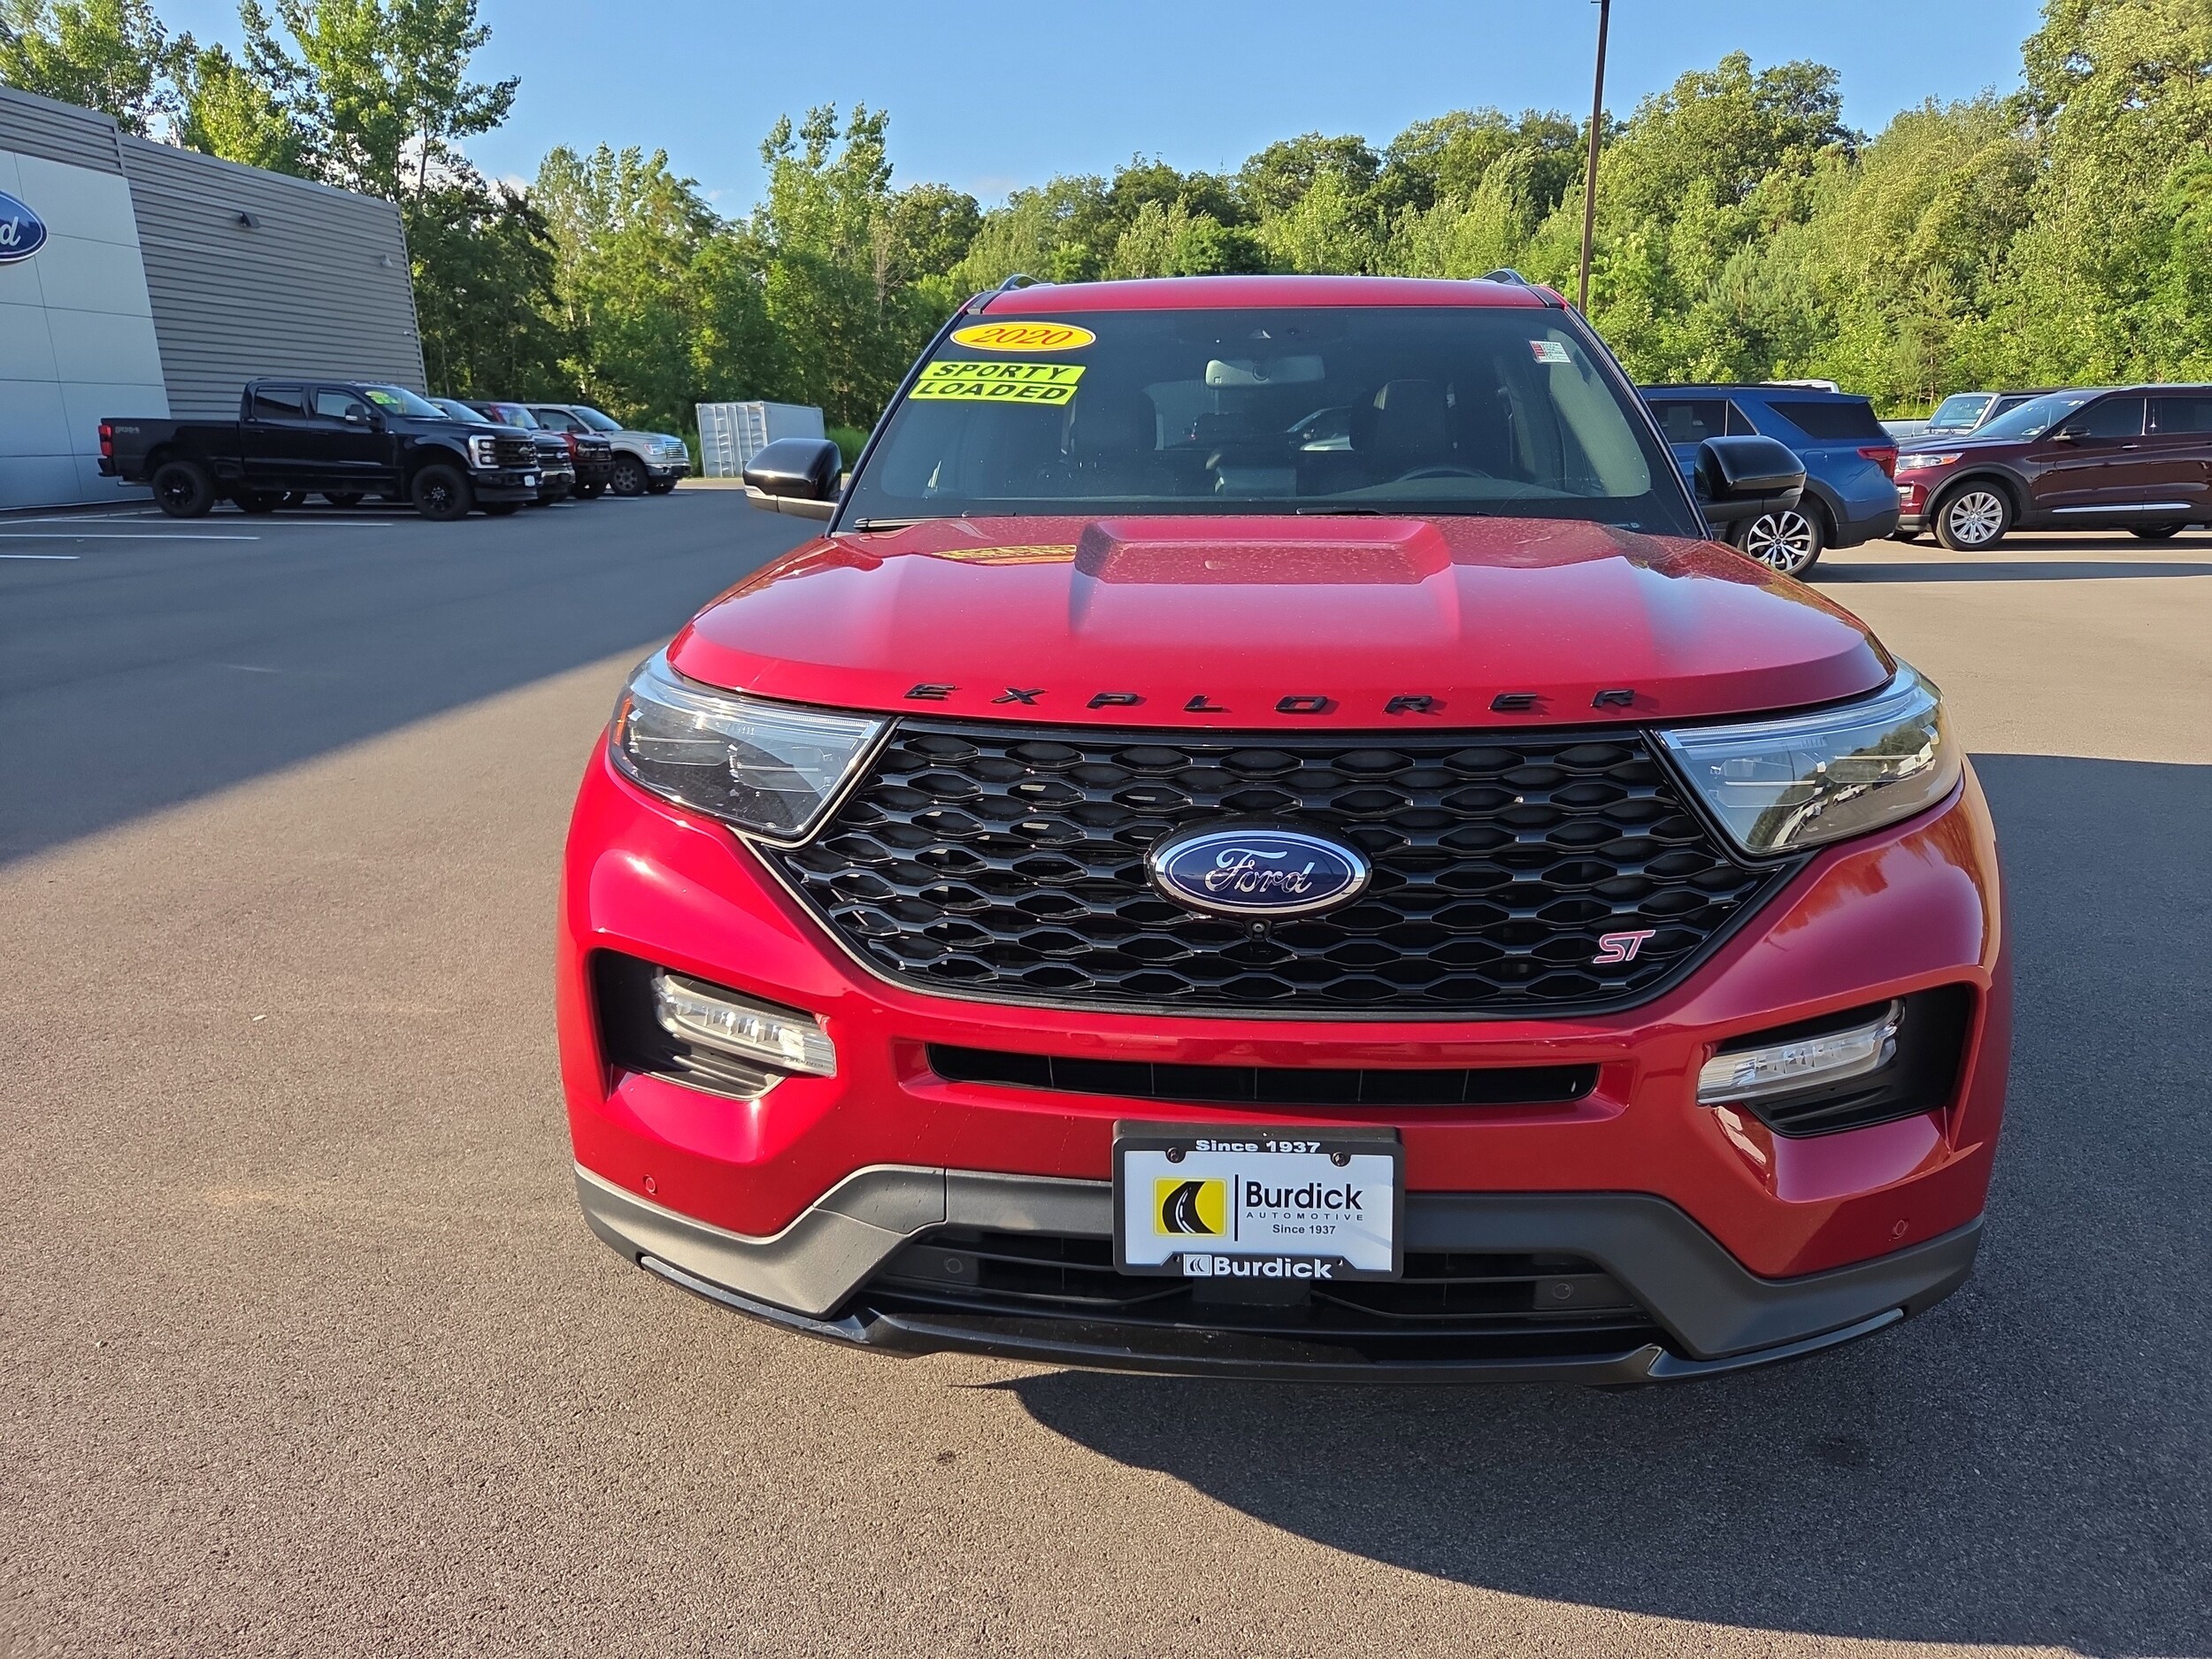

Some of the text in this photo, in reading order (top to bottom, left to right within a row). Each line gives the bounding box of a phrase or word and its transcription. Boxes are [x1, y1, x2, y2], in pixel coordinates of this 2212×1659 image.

[970, 327, 1074, 346] 2020
[933, 364, 1071, 380] SPORTY
[915, 381, 1070, 401] LOADED
[903, 681, 1637, 714] EXPLORER
[1204, 847, 1315, 896] Ford
[1593, 929, 1656, 964] ST
[1194, 1139, 1322, 1154] Since 1937
[1245, 1180, 1363, 1210] Burdick
[1246, 1211, 1363, 1222] AUTOMOTIVE
[1272, 1224, 1336, 1235] Since 1937
[1213, 1256, 1333, 1279] Burdick
